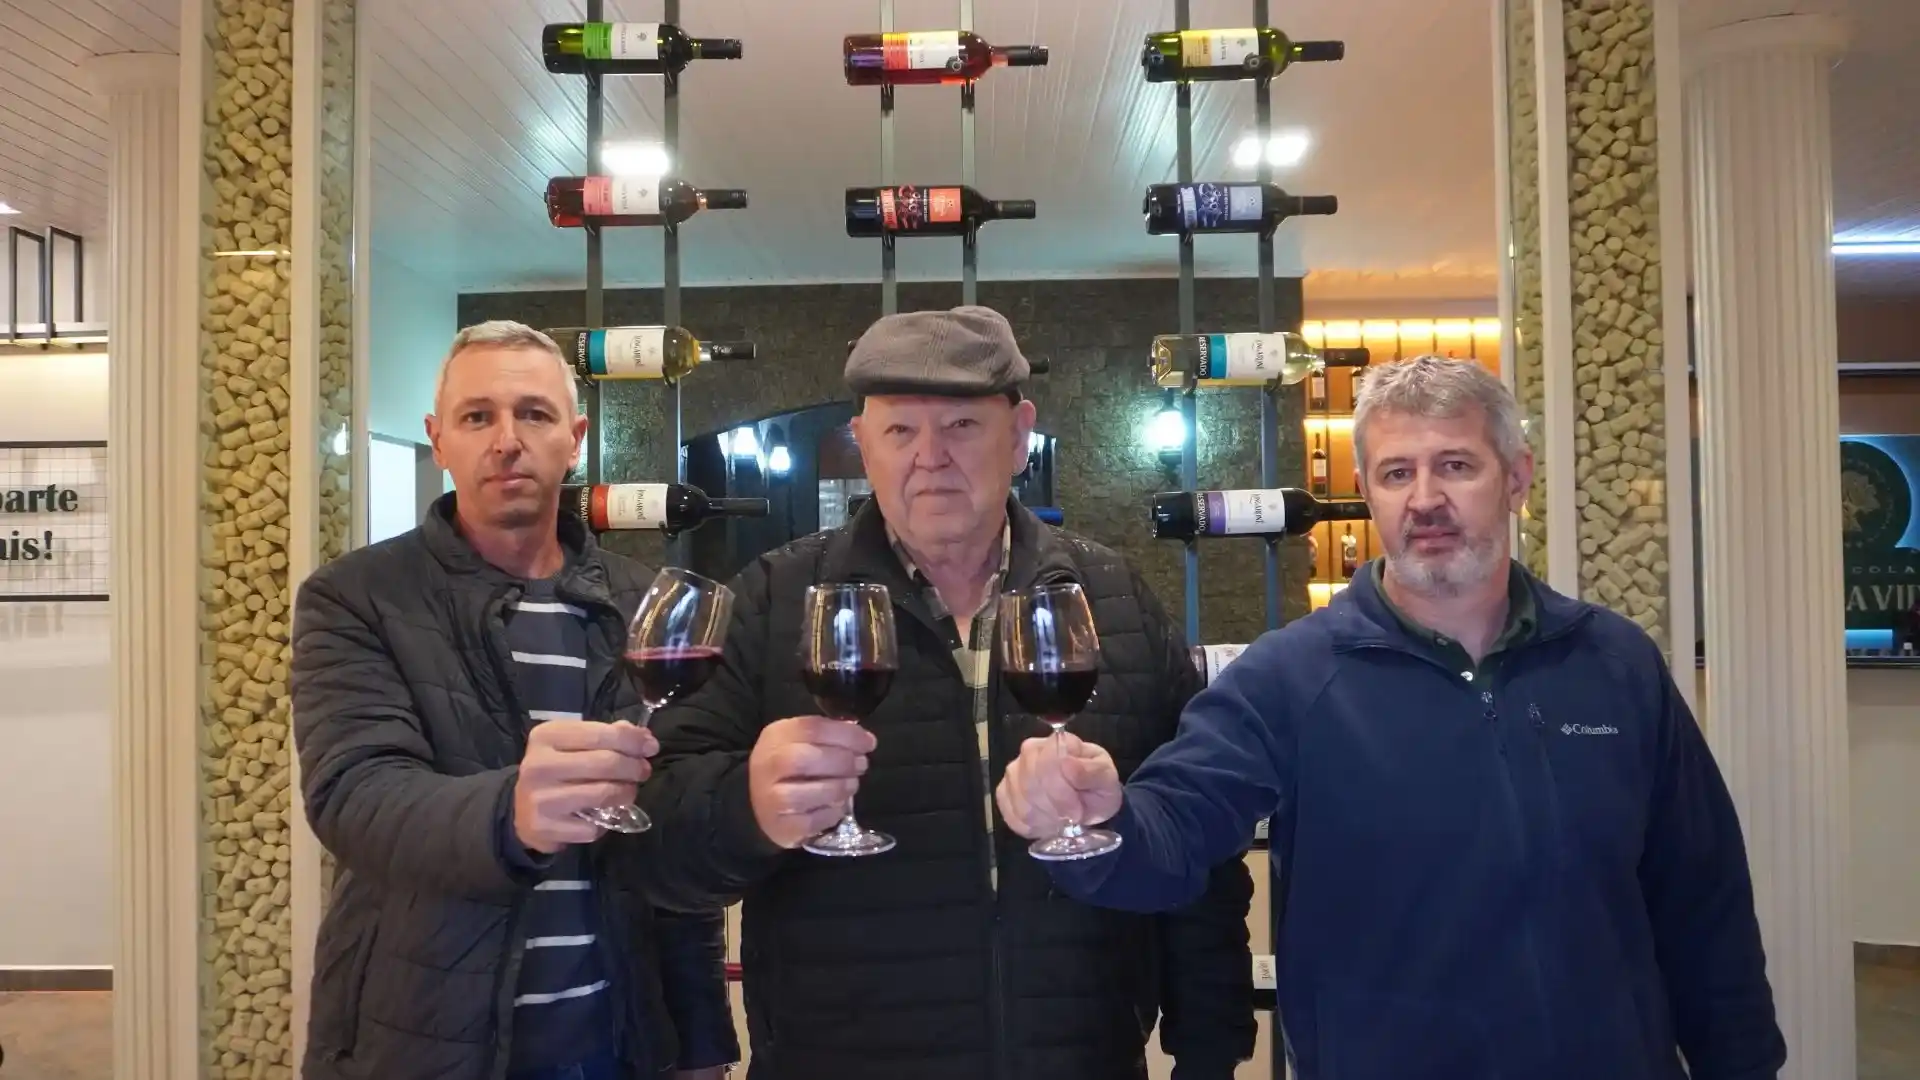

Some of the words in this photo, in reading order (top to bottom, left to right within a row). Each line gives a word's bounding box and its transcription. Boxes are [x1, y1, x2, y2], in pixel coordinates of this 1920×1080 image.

[1199, 336, 1207, 376] RESERVADO
[0, 483, 78, 513] arte
[580, 487, 590, 521] RESERVAD
[1196, 493, 1206, 531] RESERVADO
[1572, 724, 1619, 735] Columbia
